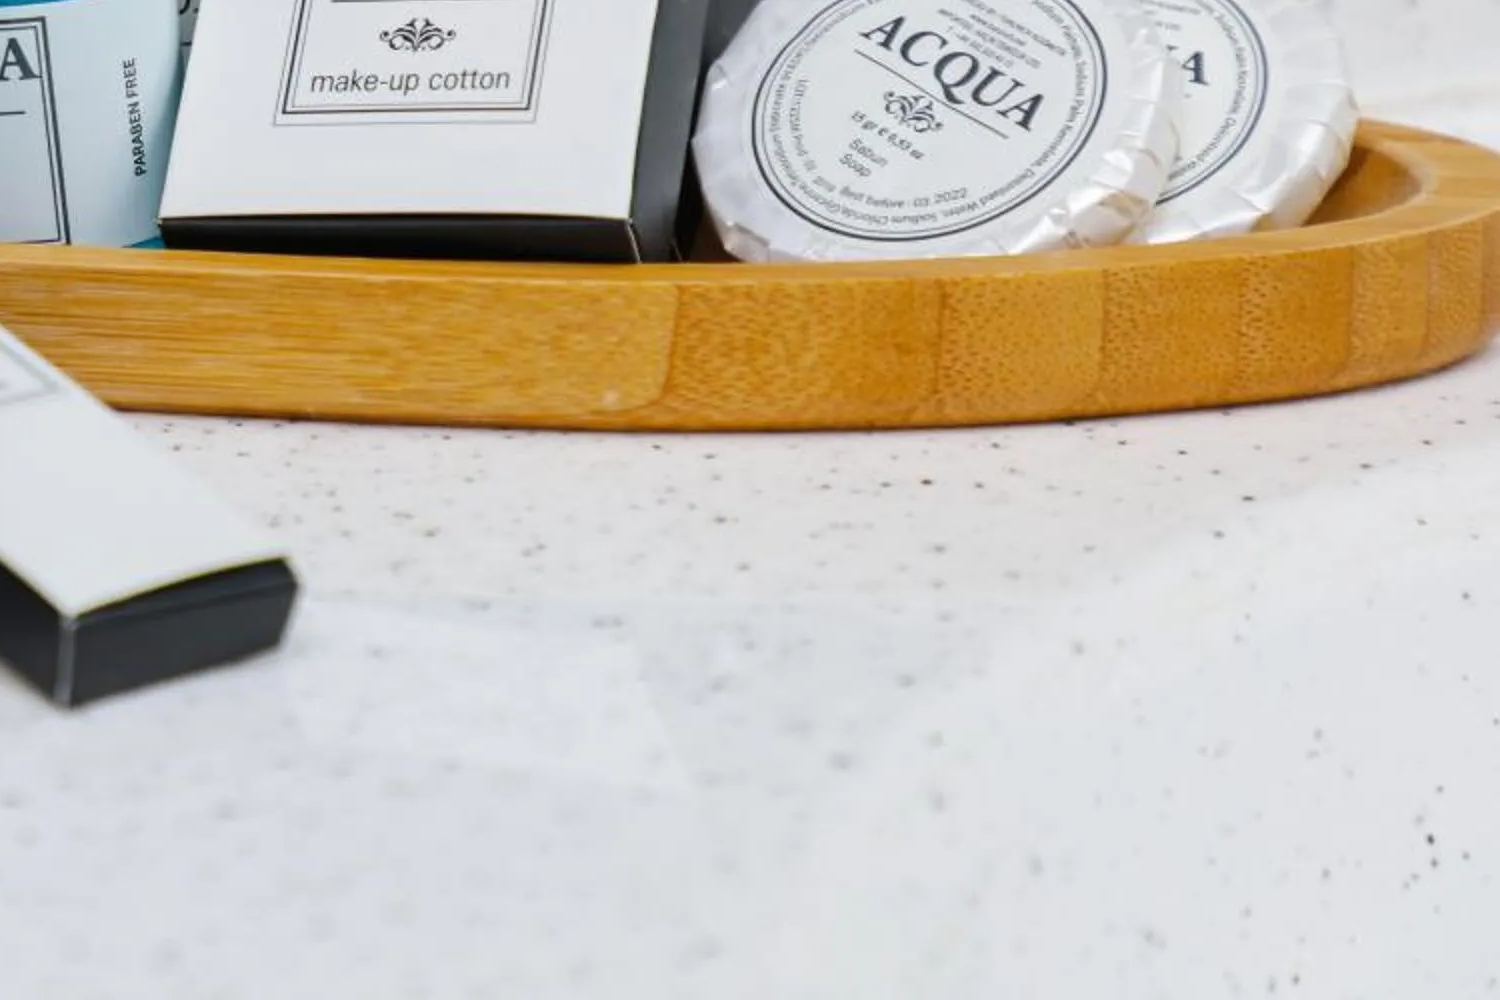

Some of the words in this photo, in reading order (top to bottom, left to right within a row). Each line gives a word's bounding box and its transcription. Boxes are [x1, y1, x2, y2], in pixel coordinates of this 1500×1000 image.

[123, 57, 139, 98] FREE
[311, 69, 419, 95] make-up
[429, 70, 510, 90] cotton
[859, 15, 1045, 132] ACQUA
[129, 101, 147, 177] PARABEN
[839, 153, 871, 177] Soap
